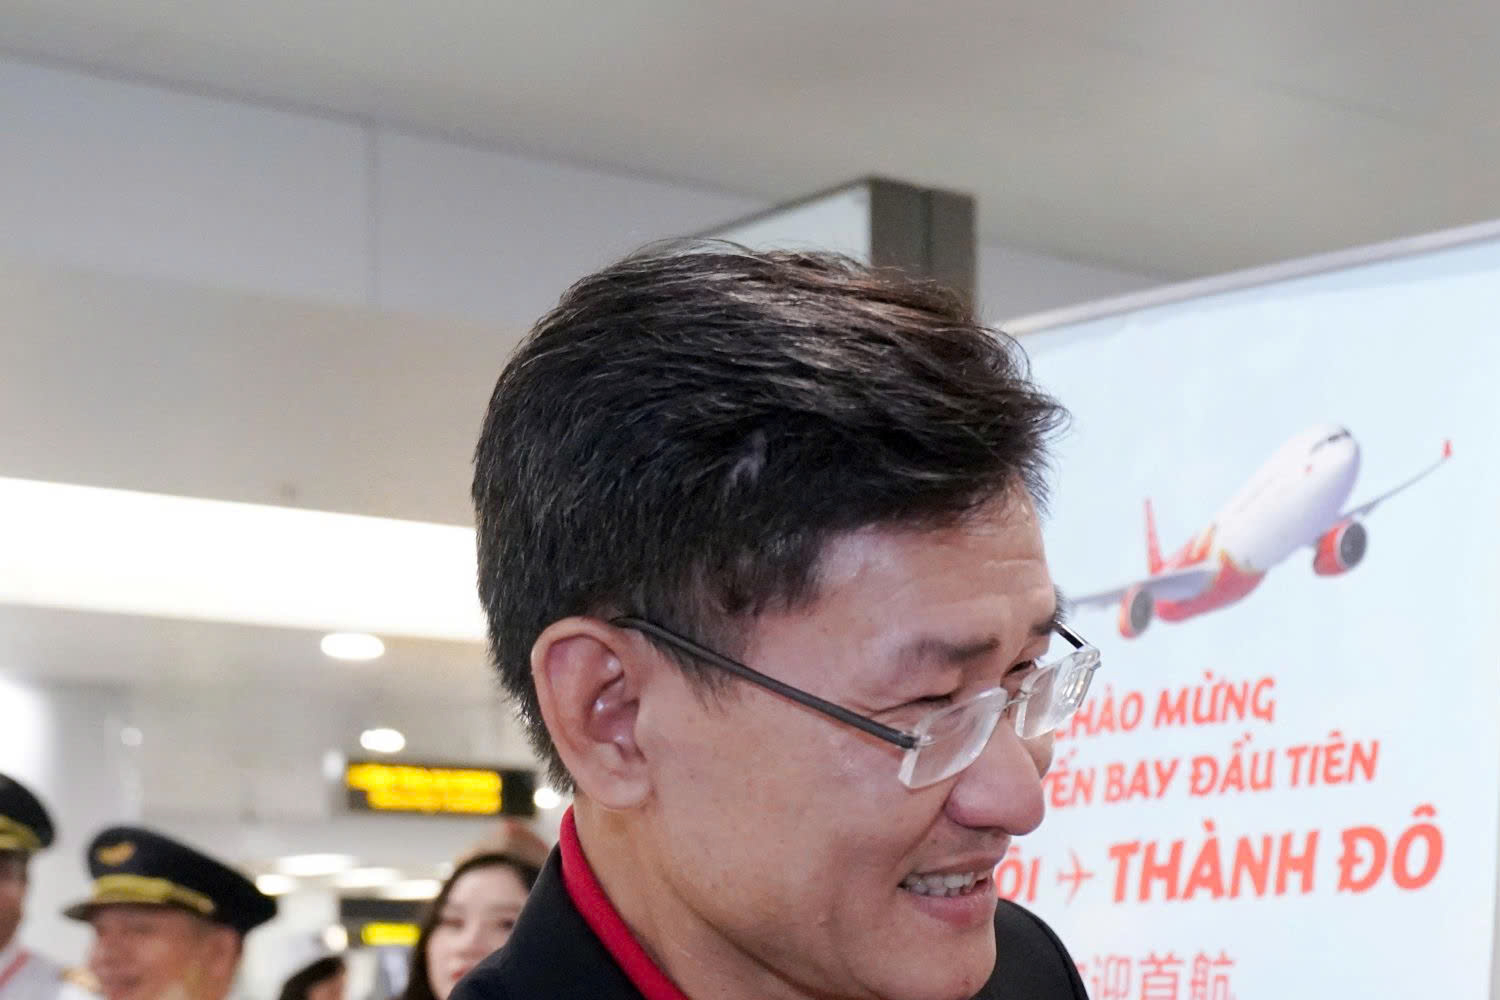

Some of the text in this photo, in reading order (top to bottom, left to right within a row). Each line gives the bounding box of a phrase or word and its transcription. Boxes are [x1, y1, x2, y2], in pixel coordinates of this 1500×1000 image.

[1055, 683, 1144, 740] HÀO
[1104, 757, 1179, 803] BAY
[1188, 733, 1274, 797] ĐẦU
[1286, 731, 1380, 788] TIÊN
[1107, 820, 1320, 905] THÀNH
[1336, 803, 1445, 895] ĐÔ
